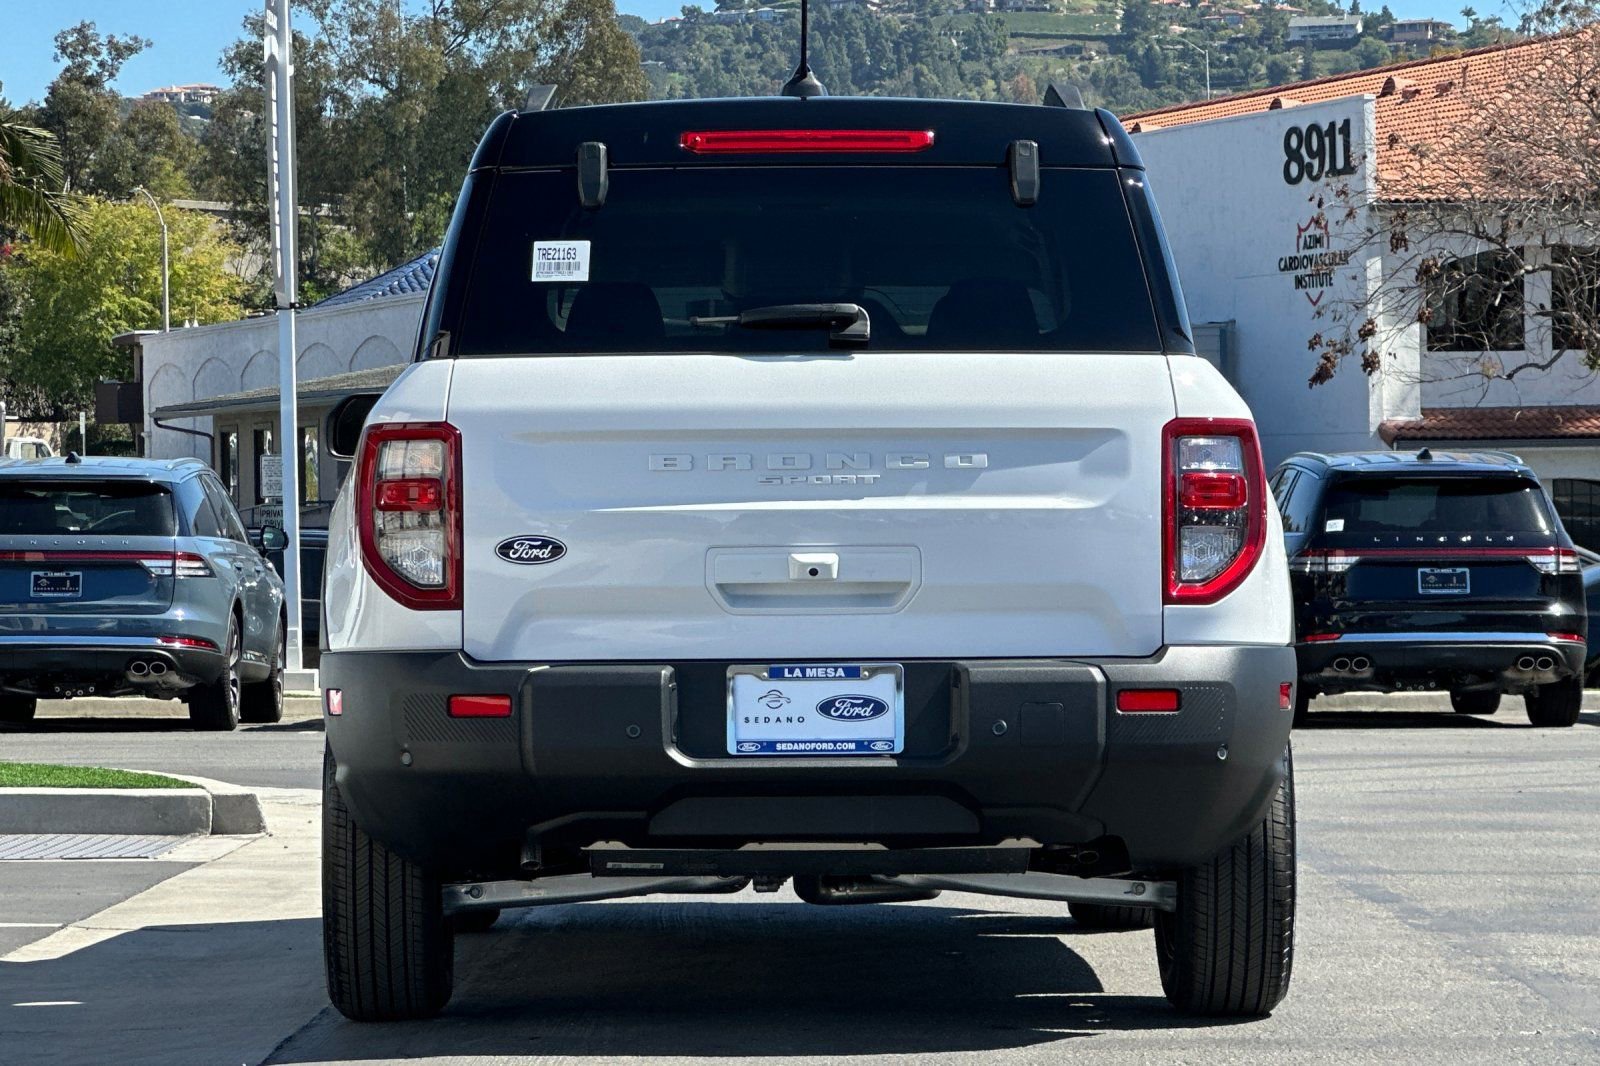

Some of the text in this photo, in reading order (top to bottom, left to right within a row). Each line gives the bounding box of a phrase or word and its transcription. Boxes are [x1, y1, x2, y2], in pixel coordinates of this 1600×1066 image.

[1283, 118, 1355, 185] 8911
[1302, 233, 1325, 250] AZIMI
[537, 247, 577, 260] TRE21163
[1295, 271, 1334, 290] INSTITUTE
[648, 452, 988, 471] BRONCO
[758, 474, 881, 485] SPORT
[262, 509, 283, 517] PRIVAT
[509, 540, 552, 558] Ford
[784, 668, 846, 678] LA MESA
[830, 697, 875, 717] Ford
[744, 716, 805, 724] SEDANO
[775, 742, 856, 751] SEDANOFORD.COM
